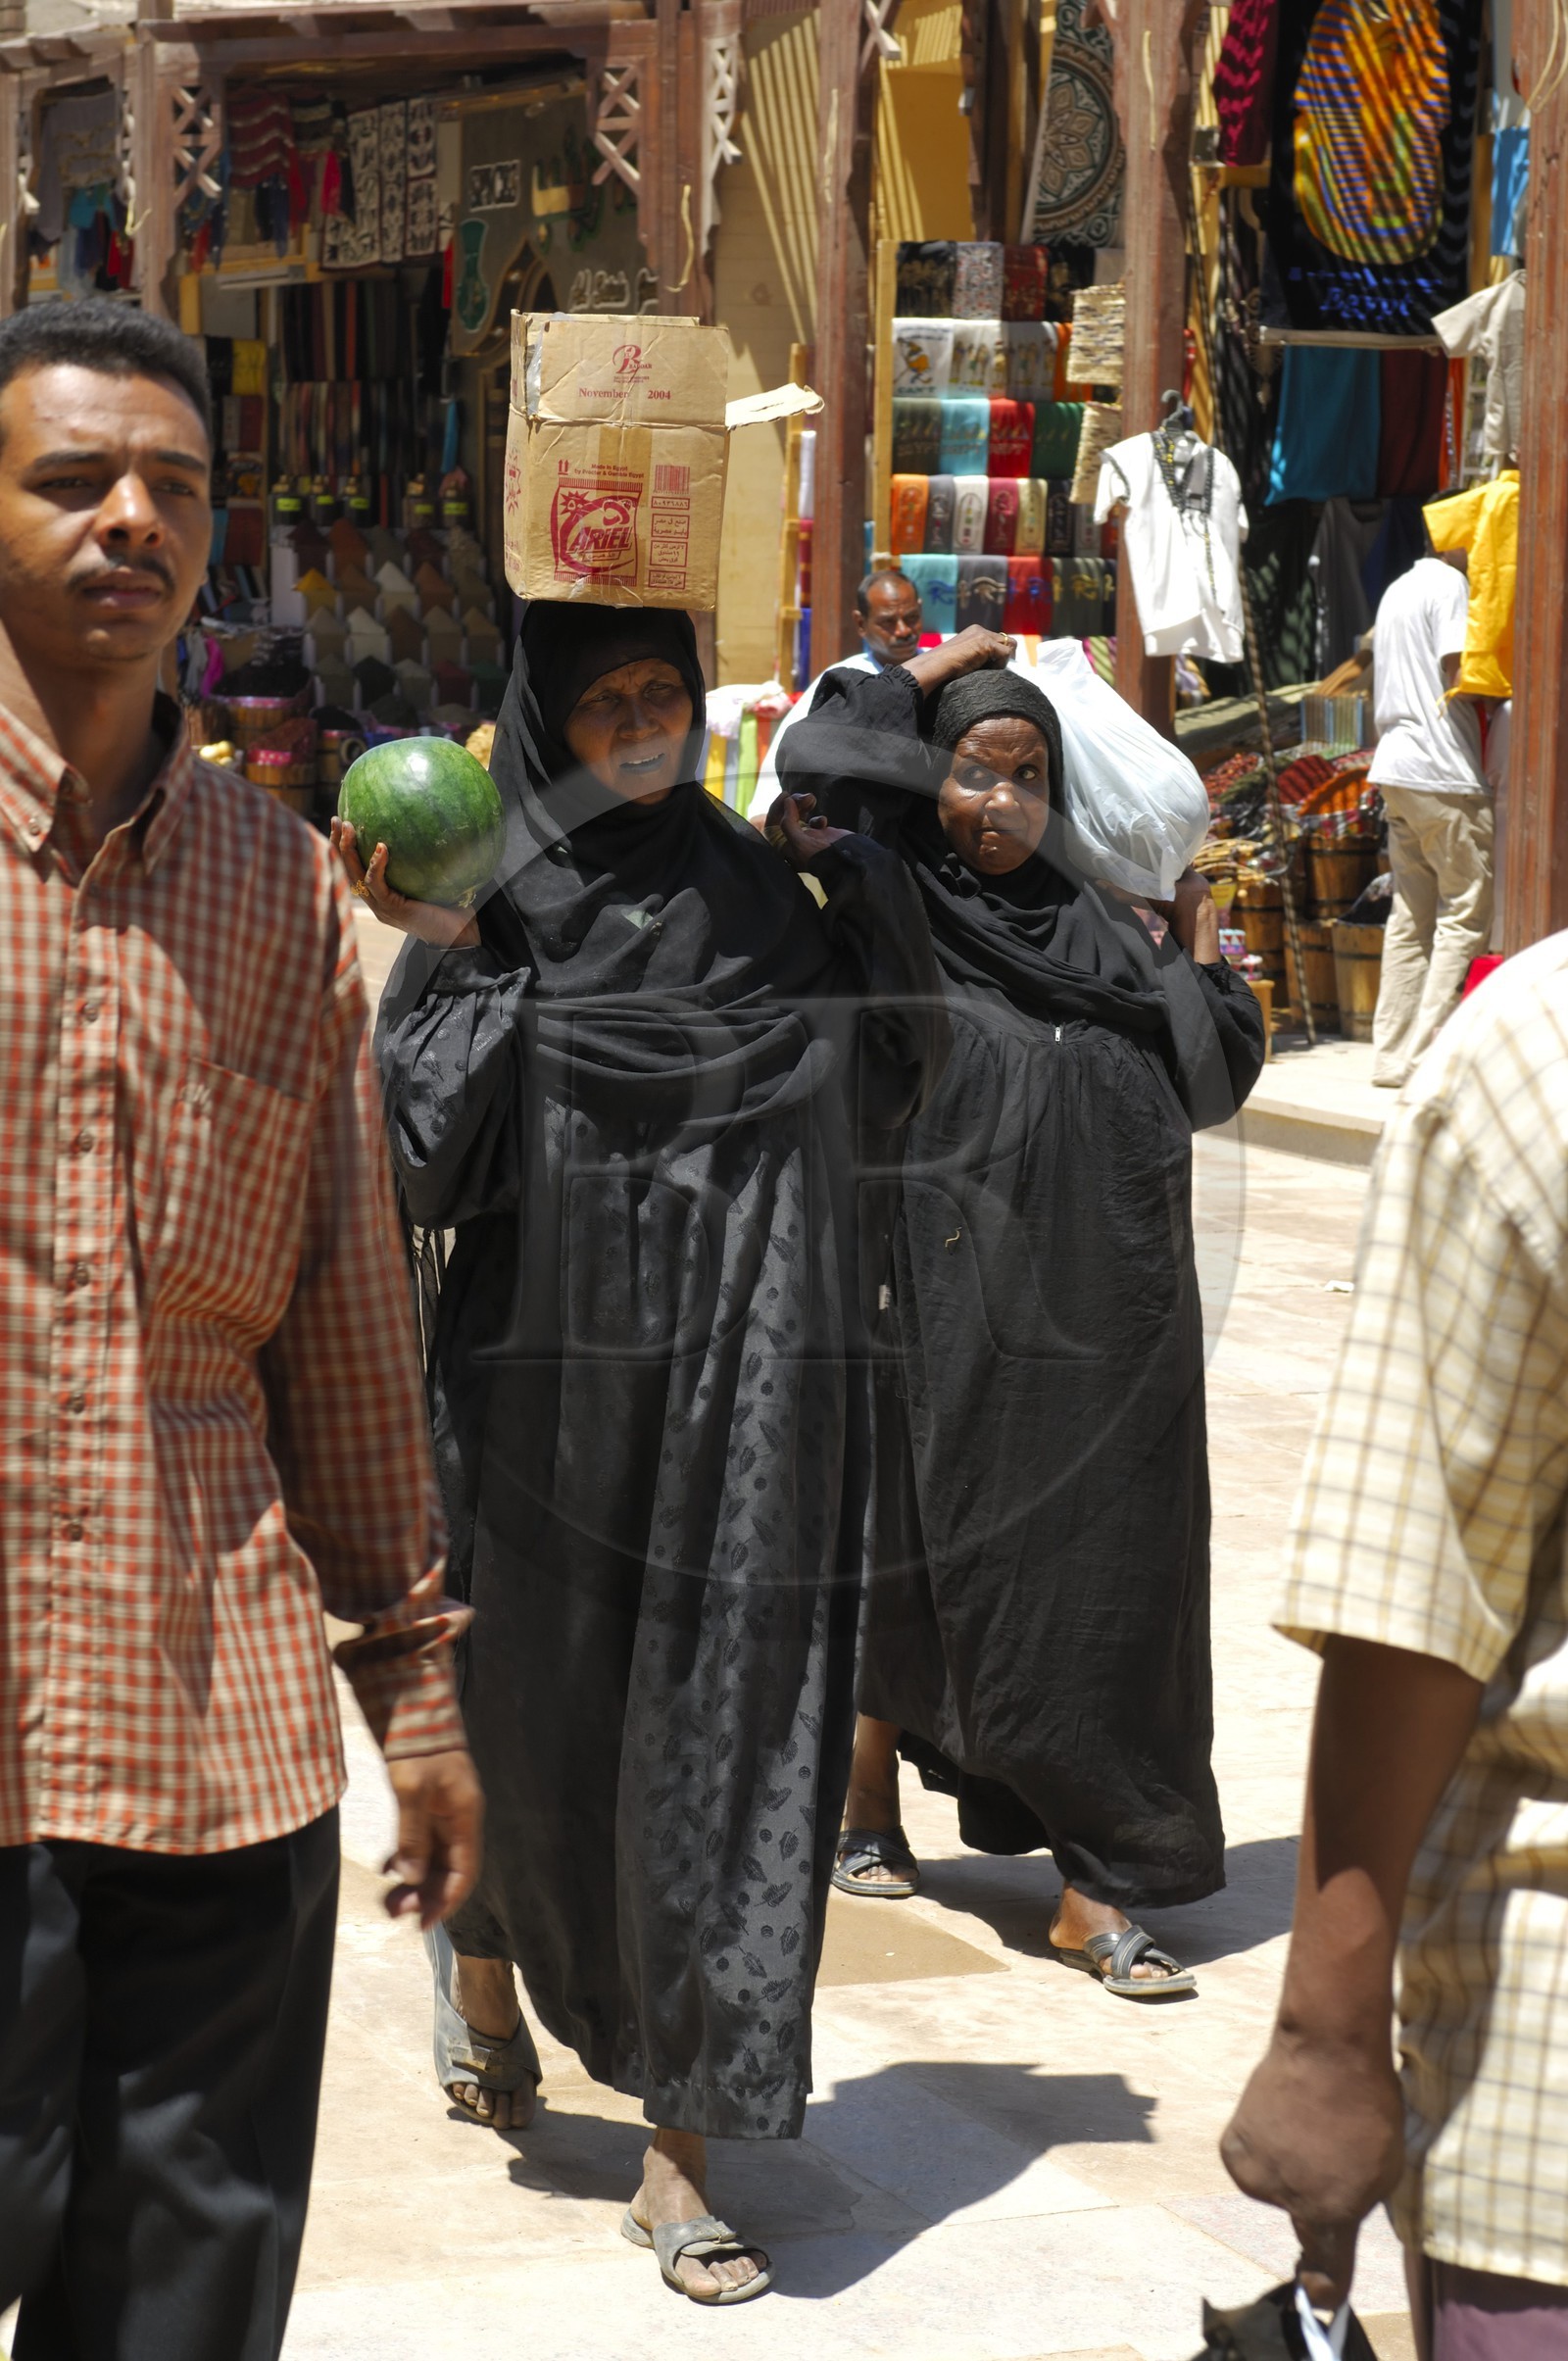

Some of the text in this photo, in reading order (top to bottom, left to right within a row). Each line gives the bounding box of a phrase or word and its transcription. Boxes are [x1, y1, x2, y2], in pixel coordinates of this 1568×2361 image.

[579, 387, 671, 400] November 2004
[567, 526, 633, 554] ARIEL
